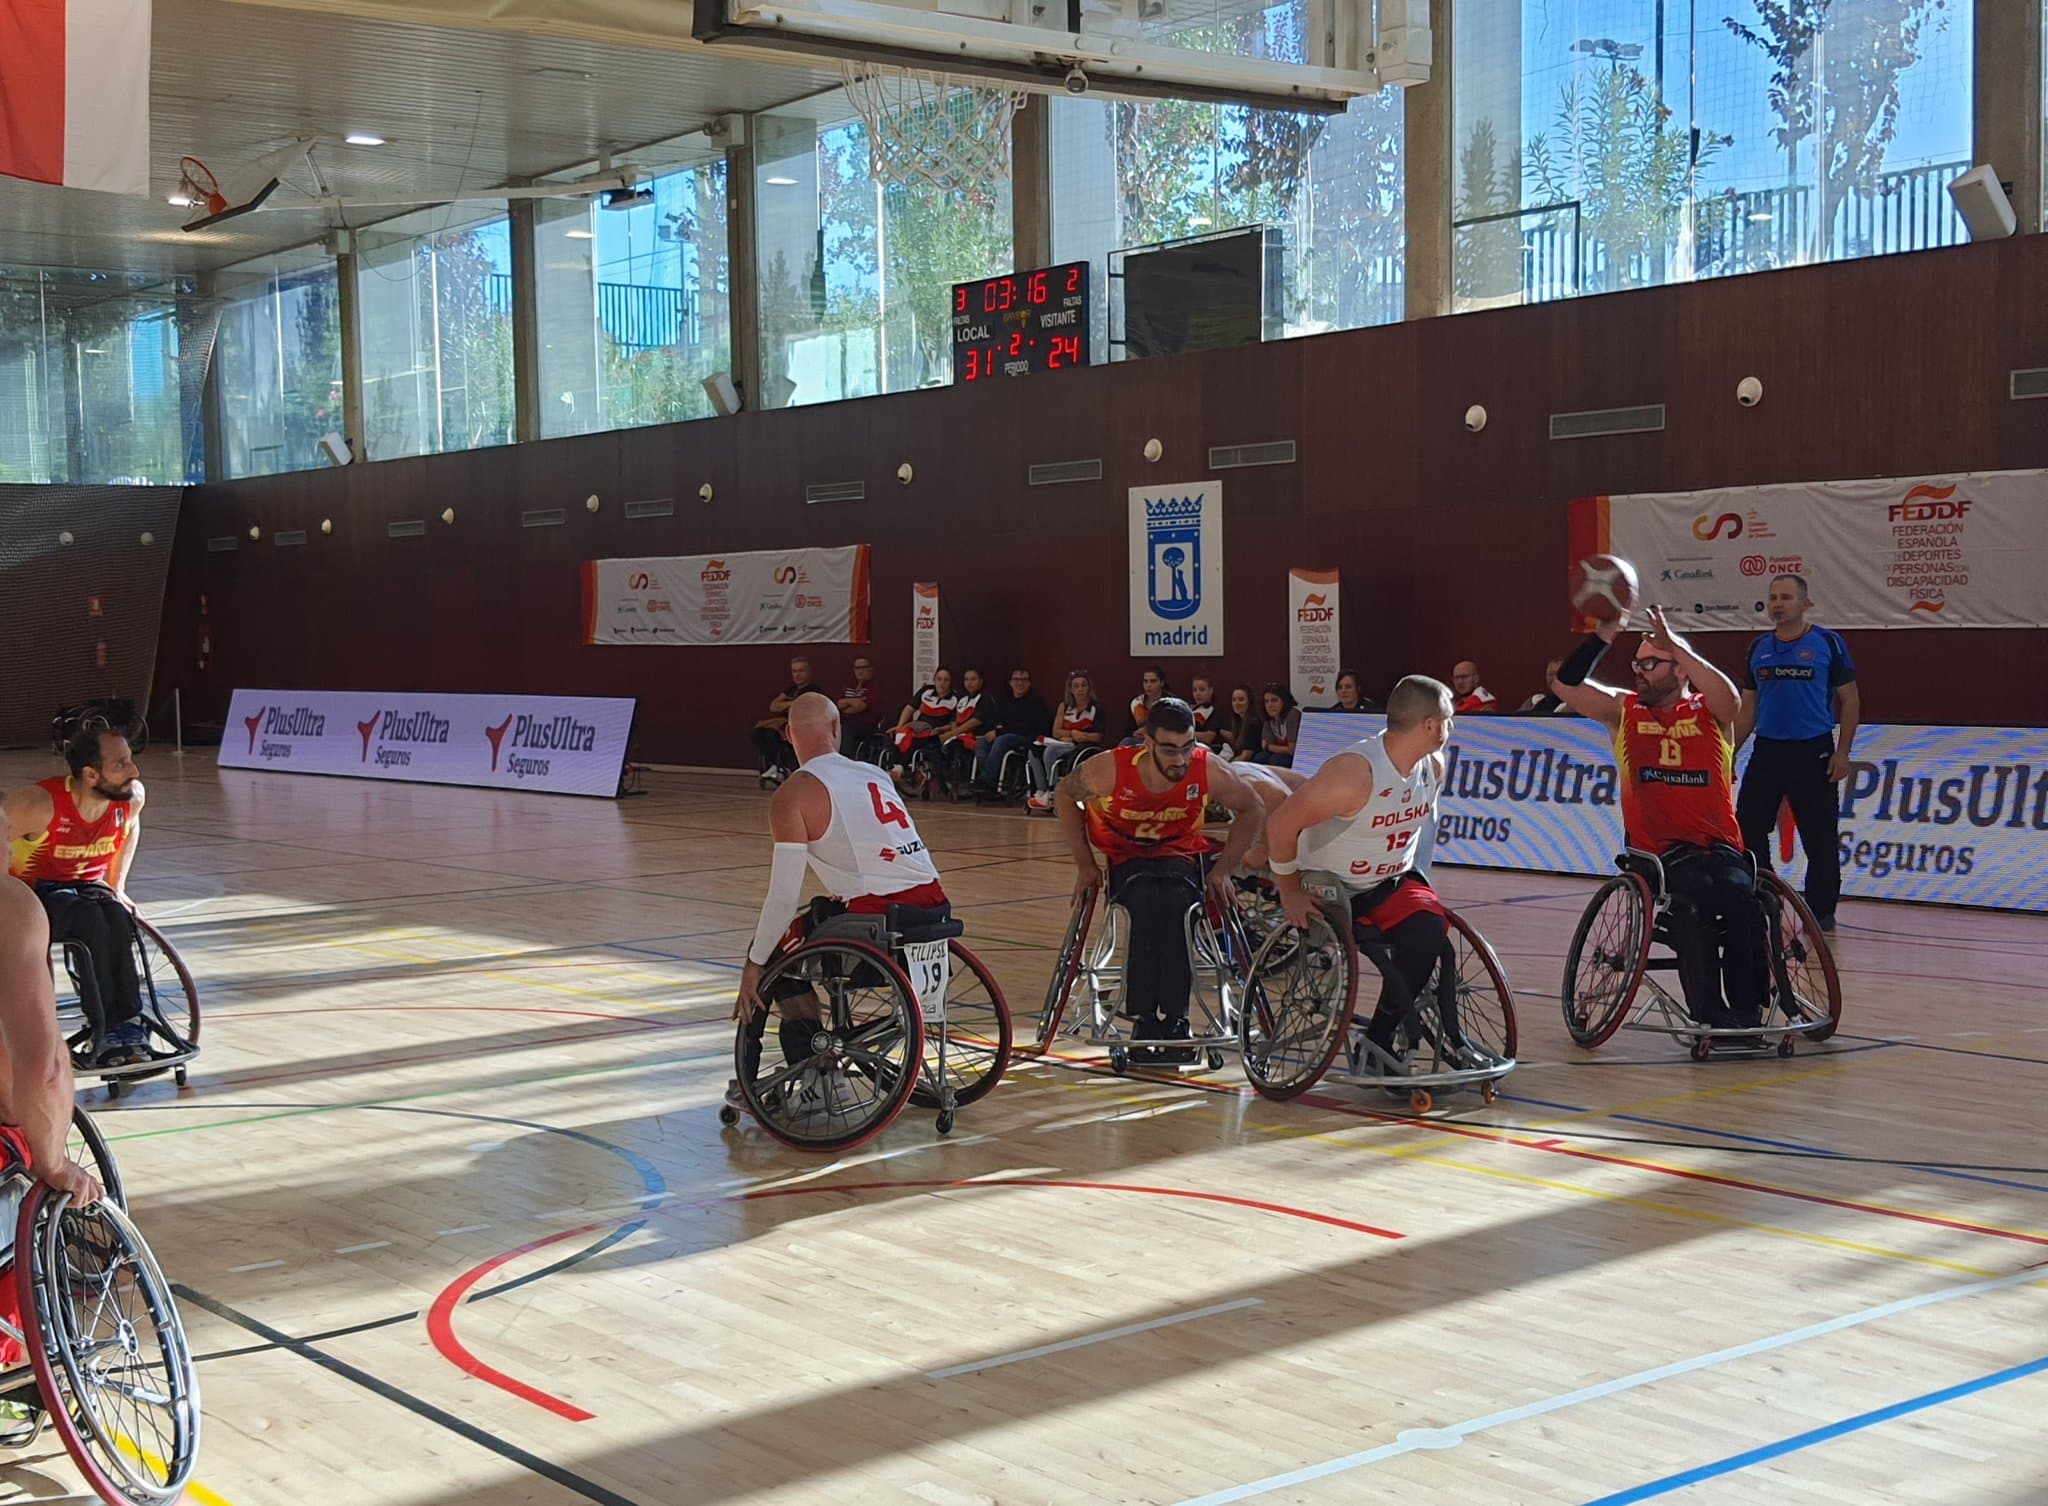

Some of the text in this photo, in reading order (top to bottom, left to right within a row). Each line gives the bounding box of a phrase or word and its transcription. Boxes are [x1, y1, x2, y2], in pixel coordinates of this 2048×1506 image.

[1067, 268, 1079, 291] 2
[956, 289, 967, 312] 3
[984, 272, 1048, 312] 03:16
[1040, 309, 1077, 328] VISITANTE
[957, 324, 990, 343] LOCAL
[1010, 333, 1022, 356] 2
[1048, 336, 1079, 369] 24
[966, 350, 993, 381] 31
[1888, 500, 1973, 522] FEDDF
[1892, 522, 1964, 536] FEDERACIÓN
[1897, 536, 1958, 549] ESPAÑOLA
[1902, 549, 1962, 562] DEPORTES
[1769, 563, 1802, 573] ONCE
[1892, 562, 1953, 575] PERSONAS
[1887, 574, 1969, 588] DISCAPACIDAD
[1297, 607, 1334, 622] FEDDF
[1145, 625, 1208, 645] madrid
[264, 706, 325, 737] PlusUltra
[379, 710, 450, 743] PlusUltra
[512, 714, 595, 752] PlusUltra
[259, 739, 292, 760] Seguros
[375, 745, 411, 769] Seguros
[507, 753, 550, 779] Seguros
[1441, 746, 1618, 806] lusUltra
[867, 782, 909, 829] 4
[1372, 802, 1431, 828] POLSKA
[1436, 813, 1512, 846] guros
[1839, 831, 1975, 878] Seguros
[922, 963, 942, 995] 19
